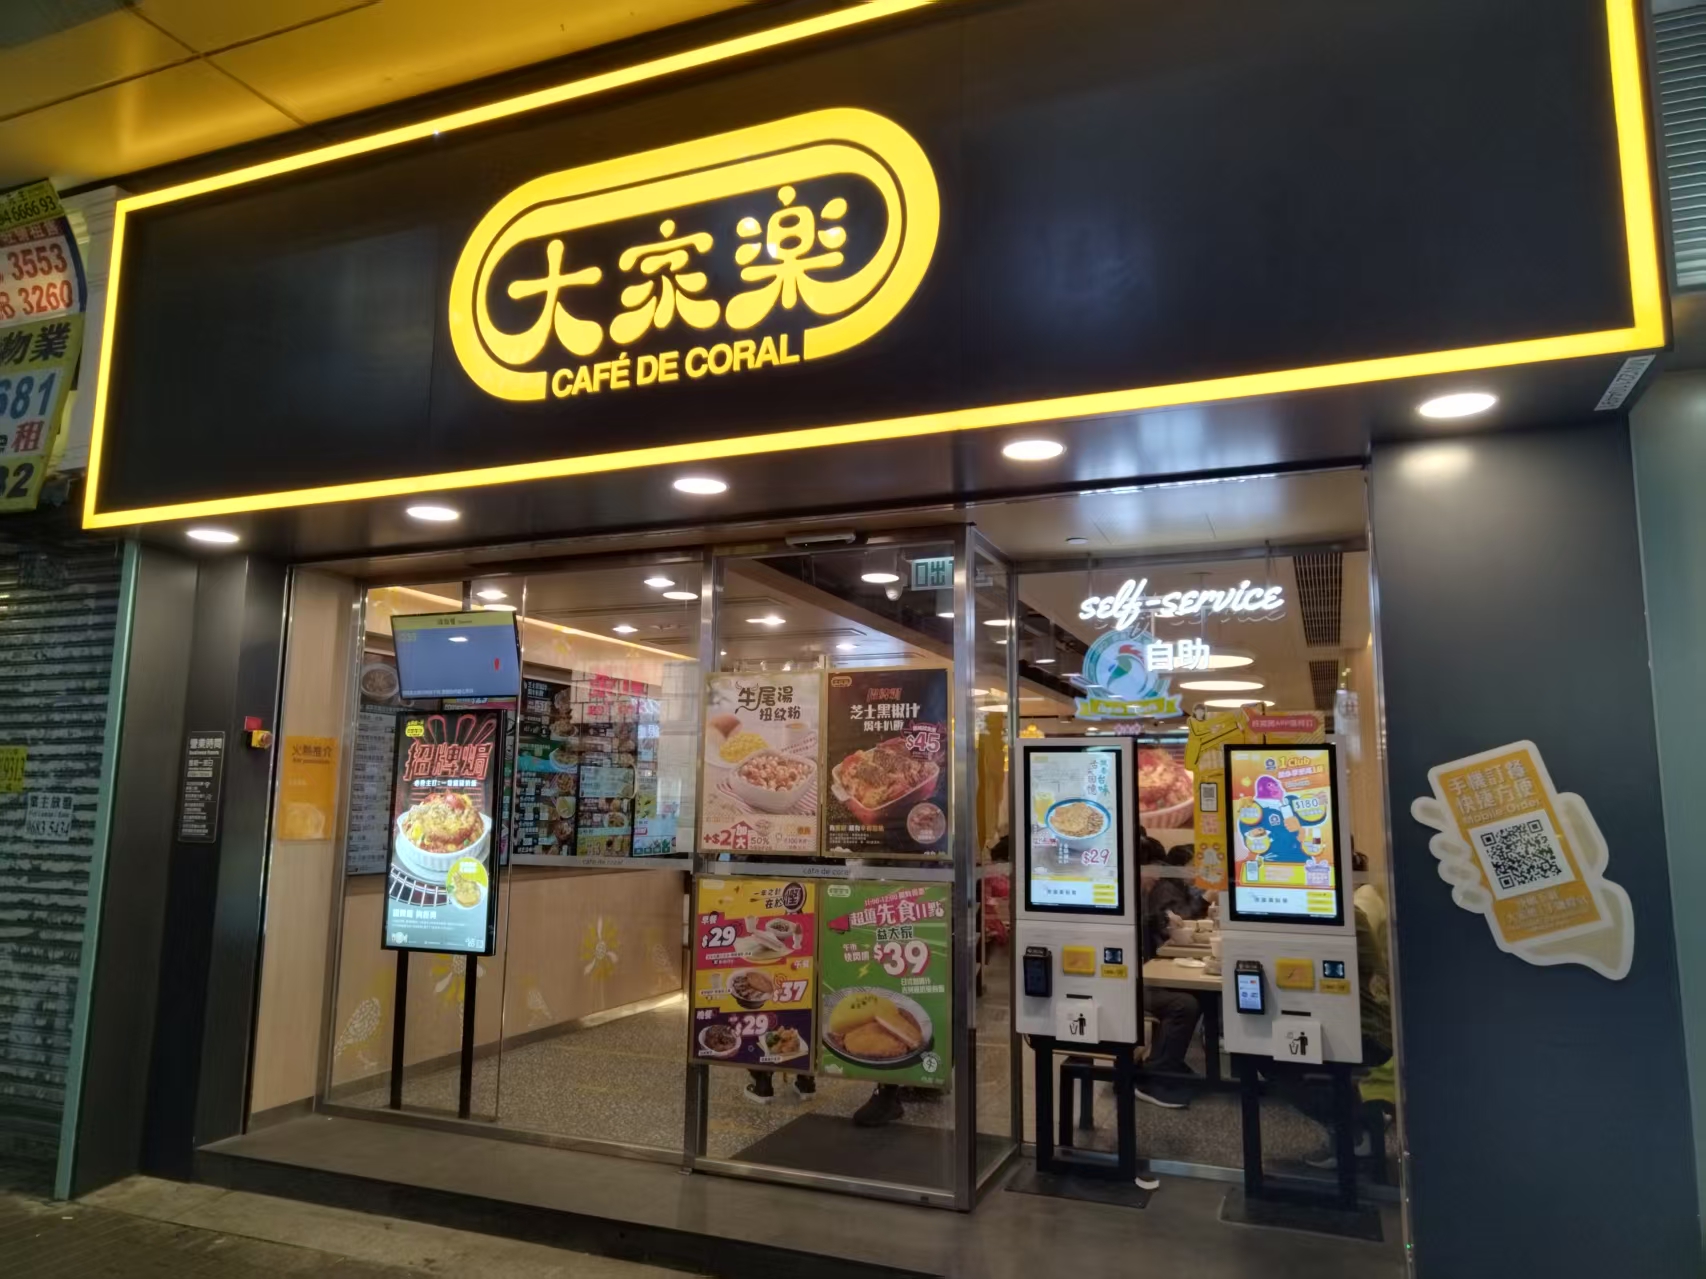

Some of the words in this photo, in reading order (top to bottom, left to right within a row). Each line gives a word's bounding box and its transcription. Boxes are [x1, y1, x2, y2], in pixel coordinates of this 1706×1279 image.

[8, 243, 67, 280] 3553
[18, 280, 73, 315] 3260
[552, 353, 630, 397] CAFÉ
[637, 350, 679, 387] DE
[685, 334, 799, 378] CORAL
[1079, 579, 1285, 630] self-service
[1147, 638, 1210, 671] 自助
[736, 685, 794, 713] 牛尾湯
[759, 706, 801, 721] 扭紋粉
[850, 702, 920, 720] 芝士黑椒汁
[906, 733, 941, 752] $45
[403, 742, 494, 781] 招牌焗
[1450, 760, 1527, 794] 手機訂餐
[1296, 799, 1318, 808] $180
[1457, 778, 1536, 815] 快捷方便
[1463, 805, 1503, 825] Mobile
[1506, 799, 1541, 814] Order
[703, 830, 731, 846] +$2
[735, 824, 748, 849] 加大
[750, 838, 769, 846] 50%
[1081, 849, 1110, 866] $29
[701, 914, 718, 925] 早餐
[702, 926, 736, 948] $29
[876, 926, 913, 940] 益大家
[873, 940, 928, 976] $39
[773, 980, 808, 1002] $37
[735, 1015, 768, 1037] $29
